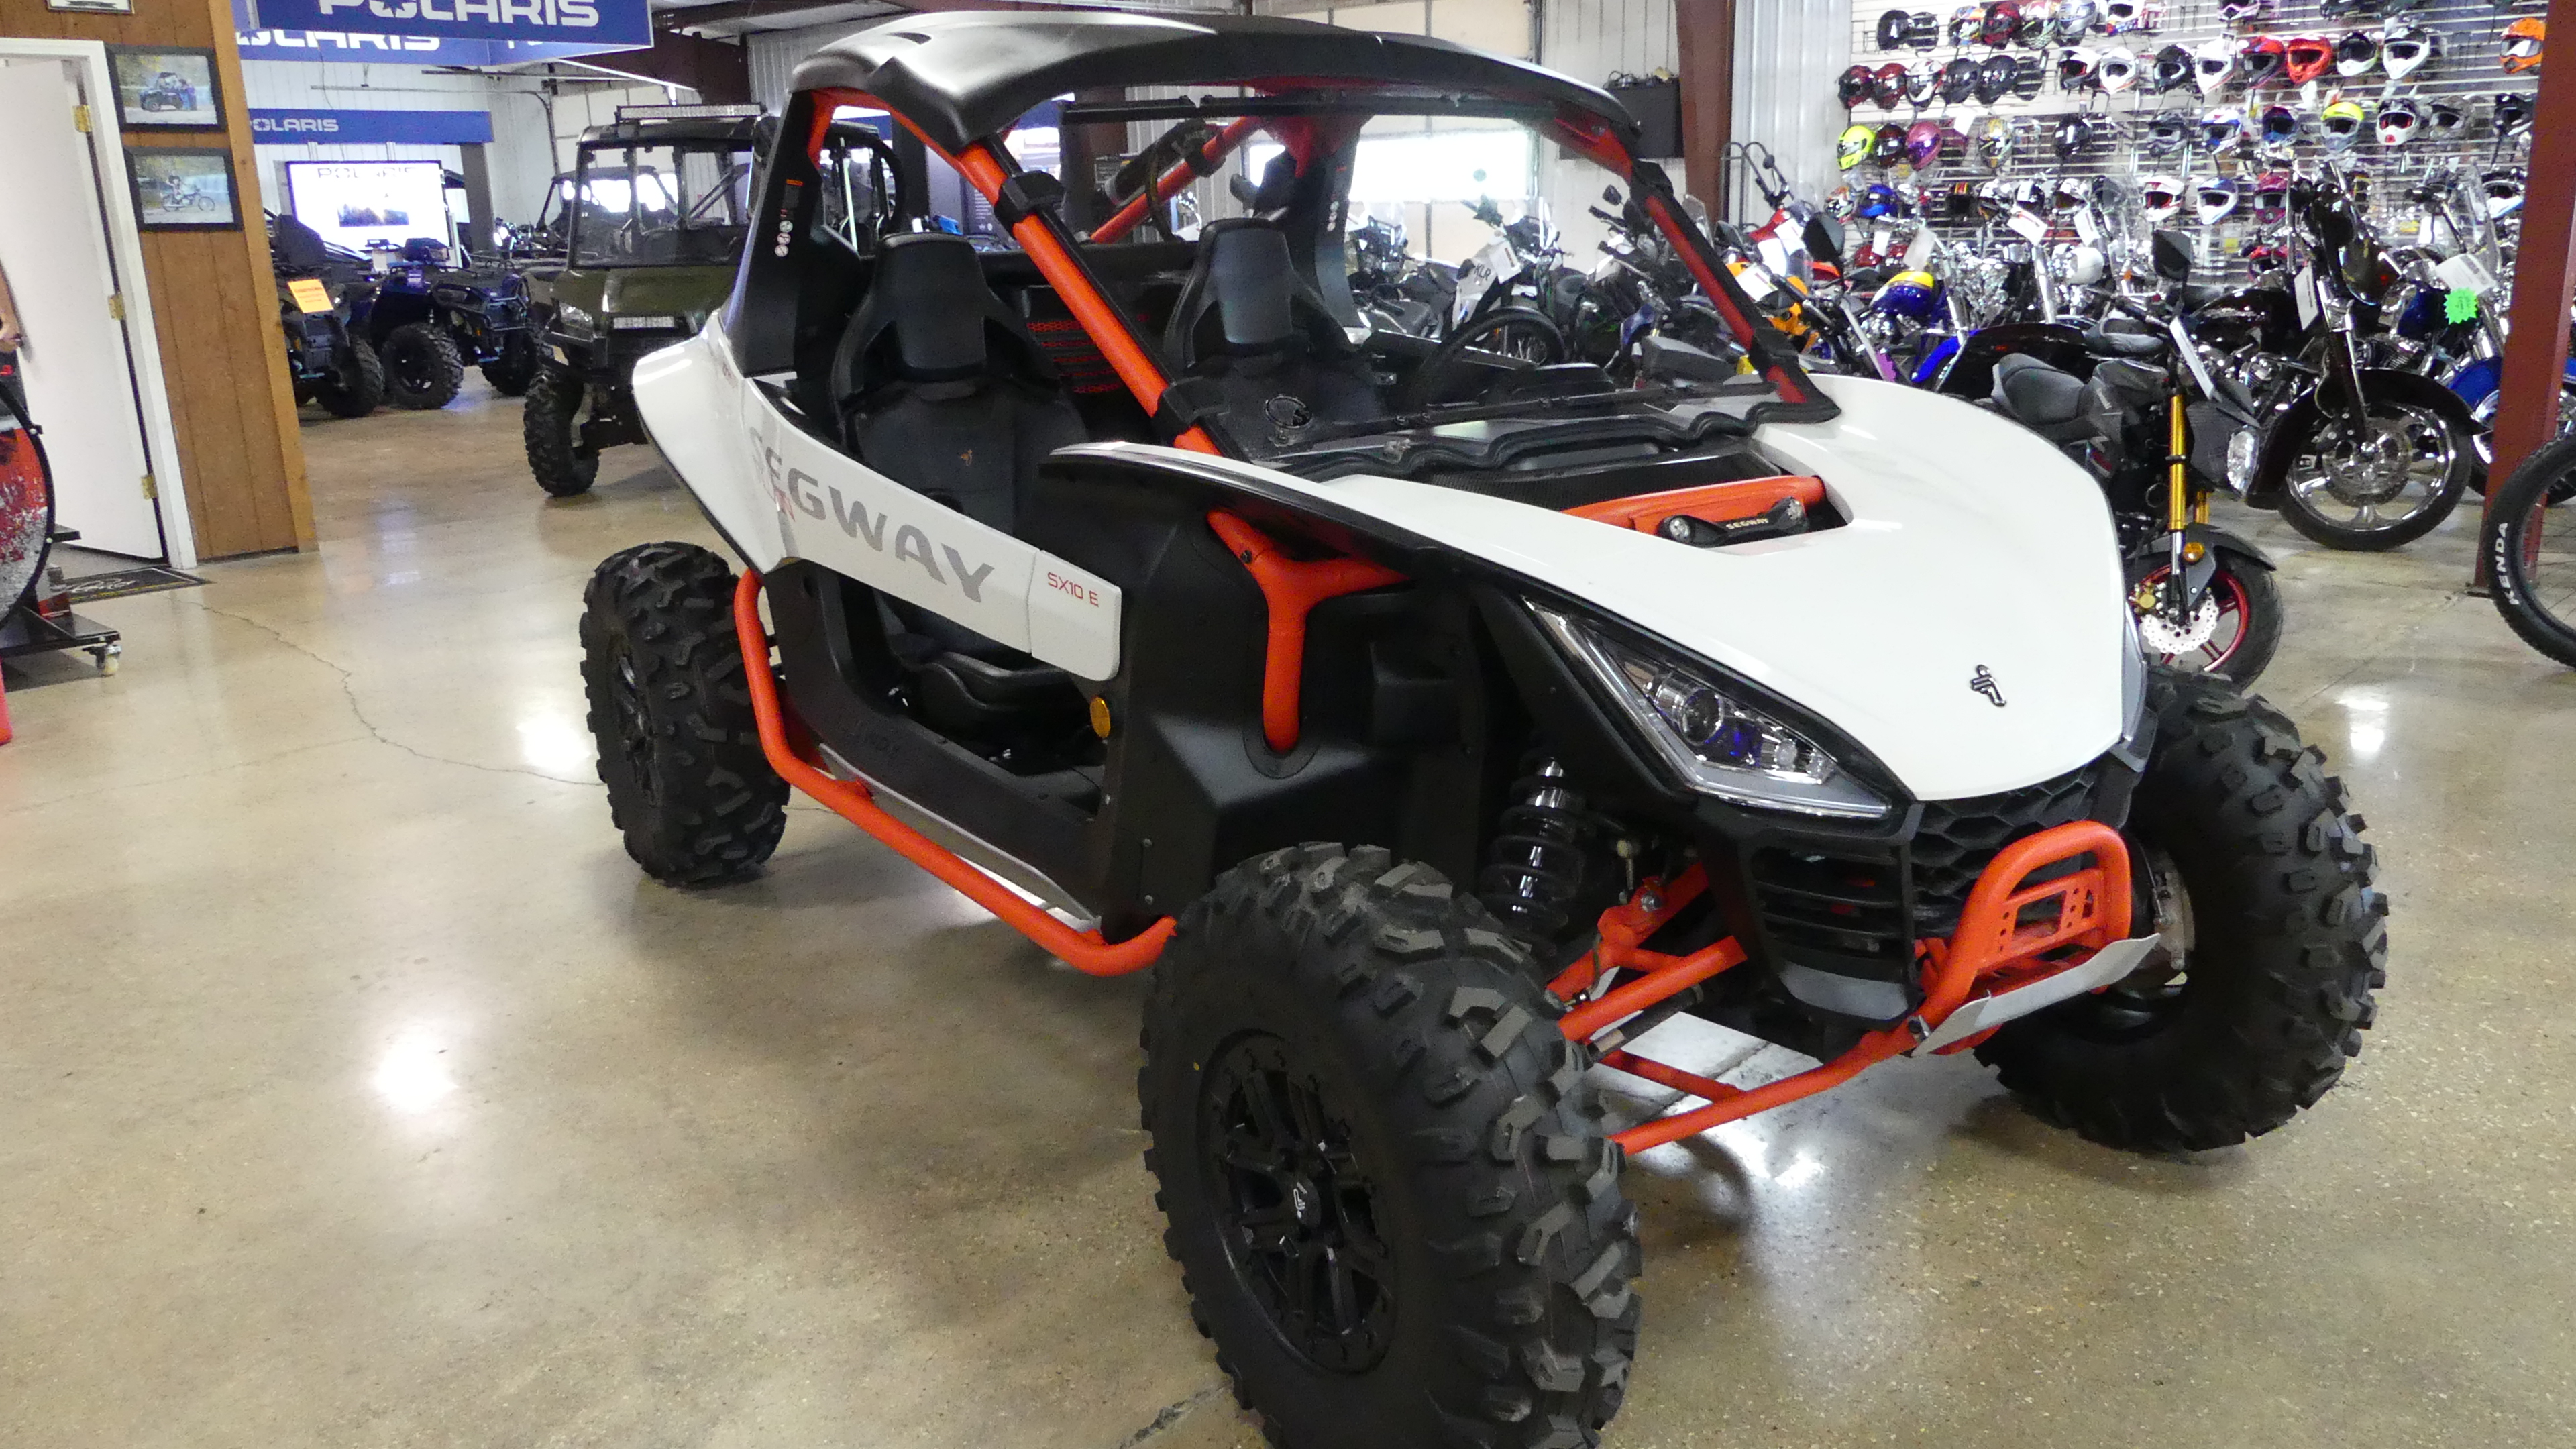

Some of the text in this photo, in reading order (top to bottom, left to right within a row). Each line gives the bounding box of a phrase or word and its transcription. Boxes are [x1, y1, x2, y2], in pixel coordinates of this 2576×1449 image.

[1474, 262, 1491, 281] KLR
[1725, 517, 1769, 530] SEGWAY
[2495, 522, 2520, 605] KENDA
[1047, 572, 1099, 608] SX10 E
